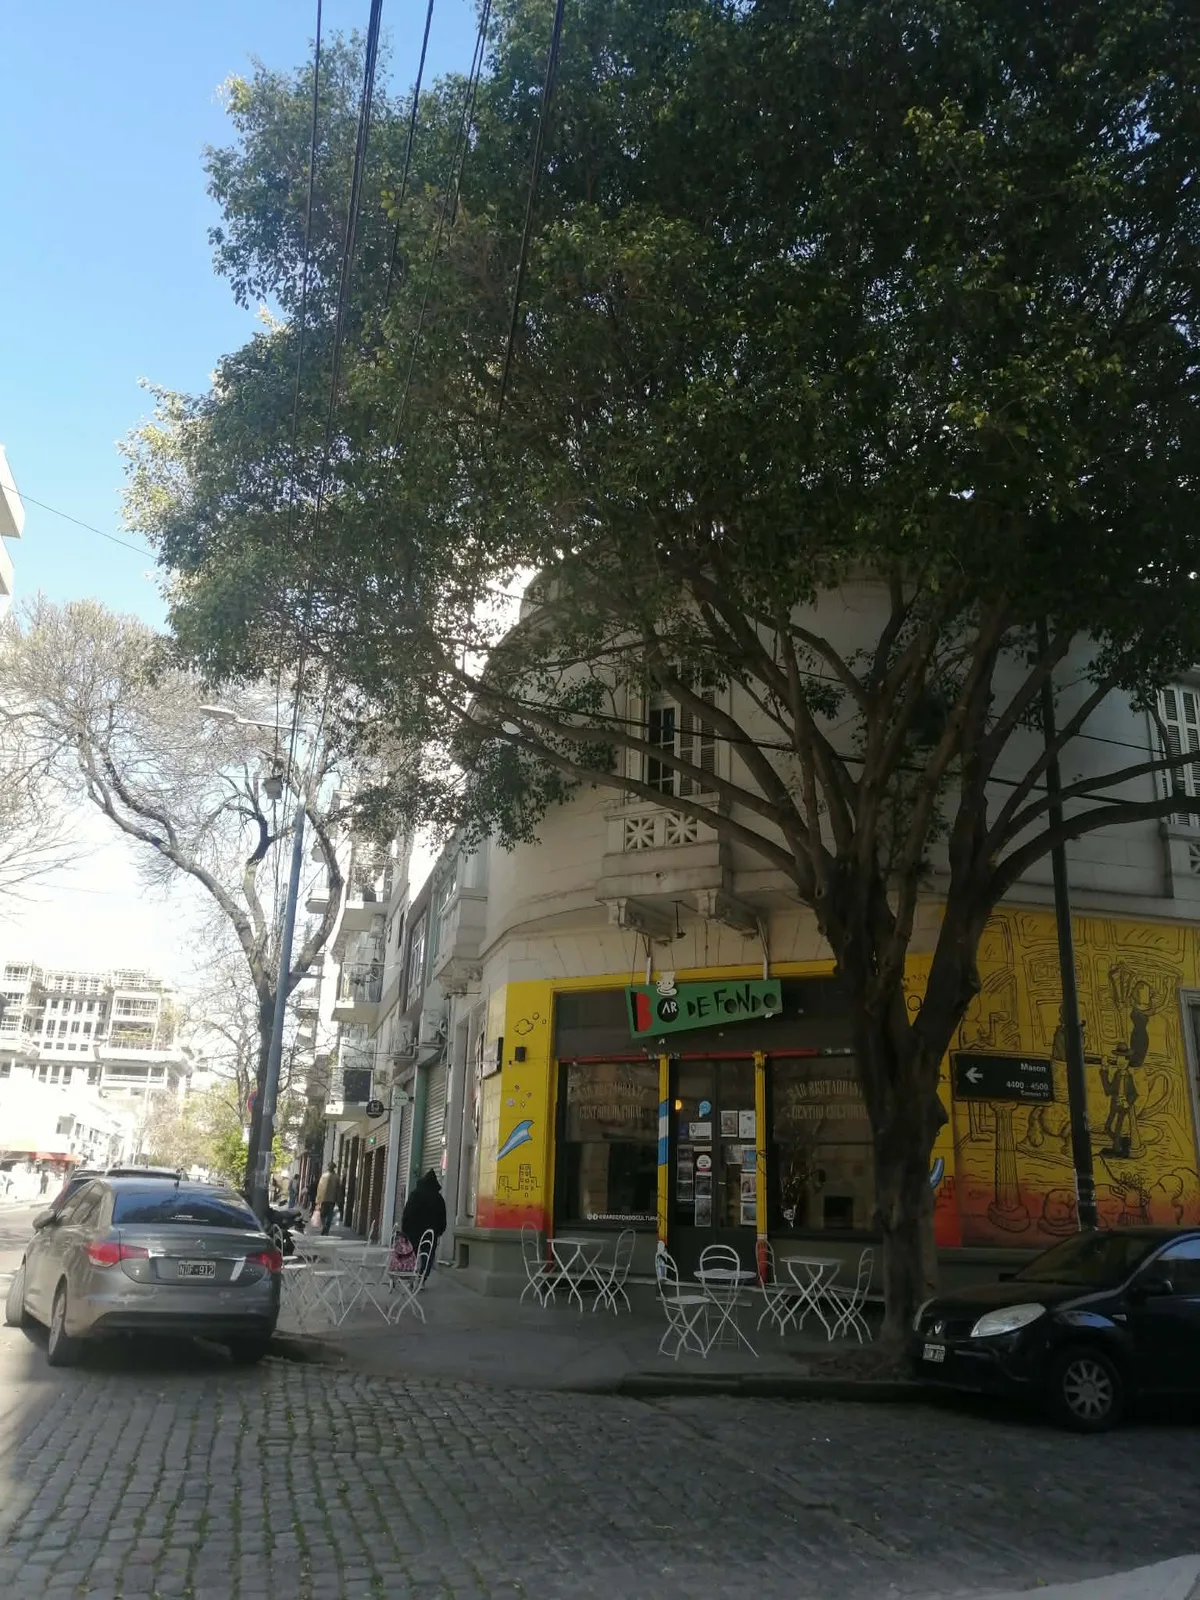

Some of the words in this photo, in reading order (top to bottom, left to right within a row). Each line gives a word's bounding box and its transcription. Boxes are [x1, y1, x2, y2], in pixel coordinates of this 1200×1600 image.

[686, 996, 711, 1019] DE
[713, 984, 778, 1015] FONDO
[1020, 1062, 1047, 1073] Mason
[1006, 1080, 1025, 1089] 4400
[199, 1265, 214, 1275] 912
